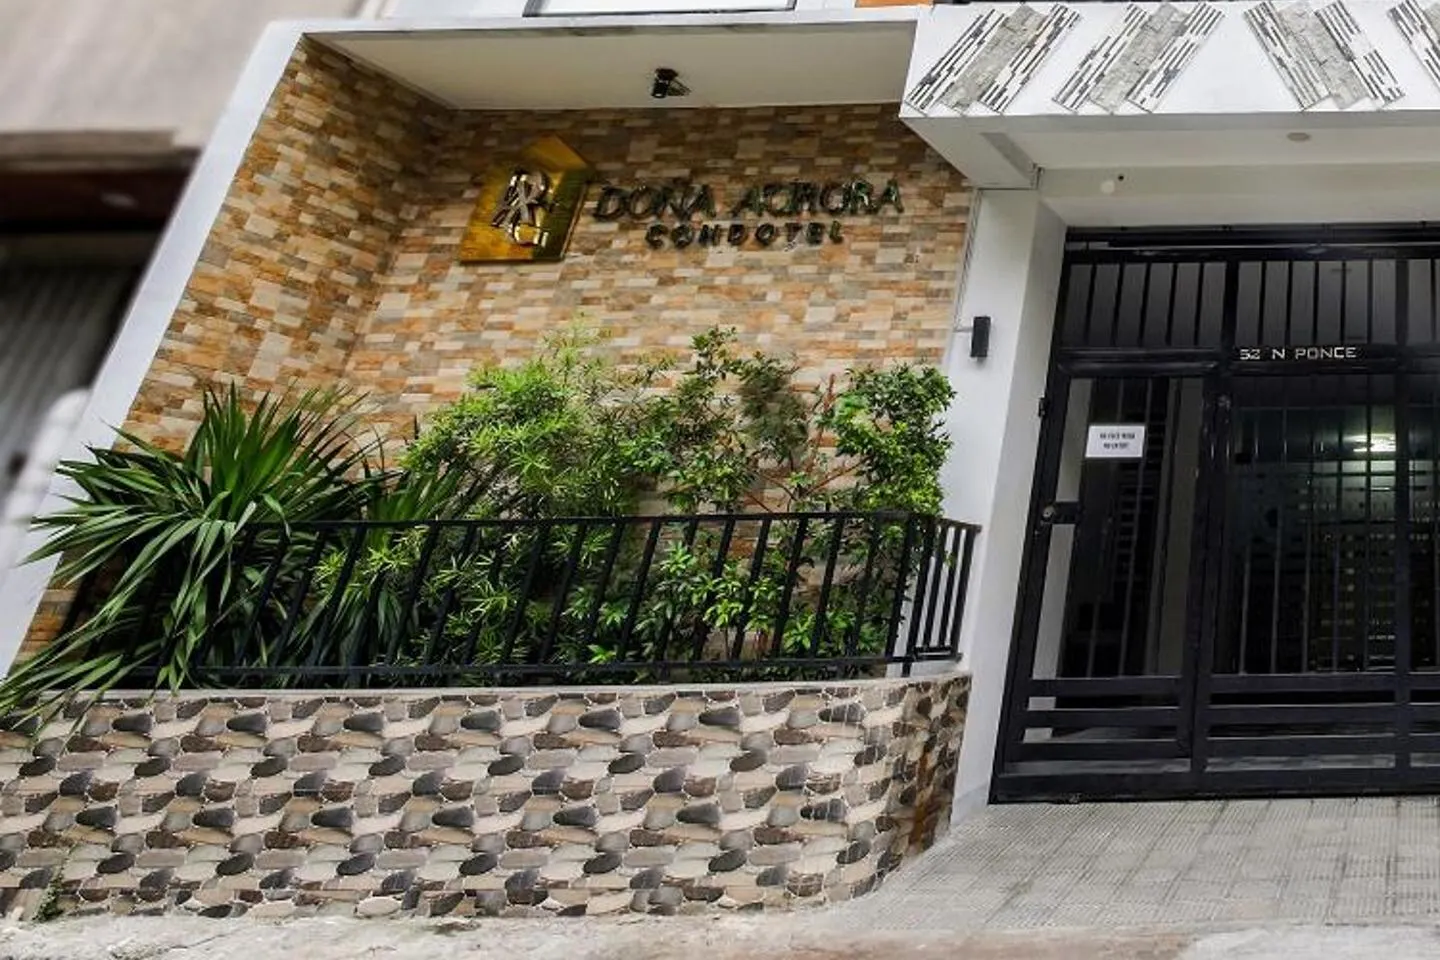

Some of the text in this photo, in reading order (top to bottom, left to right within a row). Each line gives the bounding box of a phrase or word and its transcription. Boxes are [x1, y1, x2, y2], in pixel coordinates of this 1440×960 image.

[645, 220, 844, 249] CONDOTEL
[1271, 347, 1286, 360] N
[1295, 346, 1357, 360] PONCE
